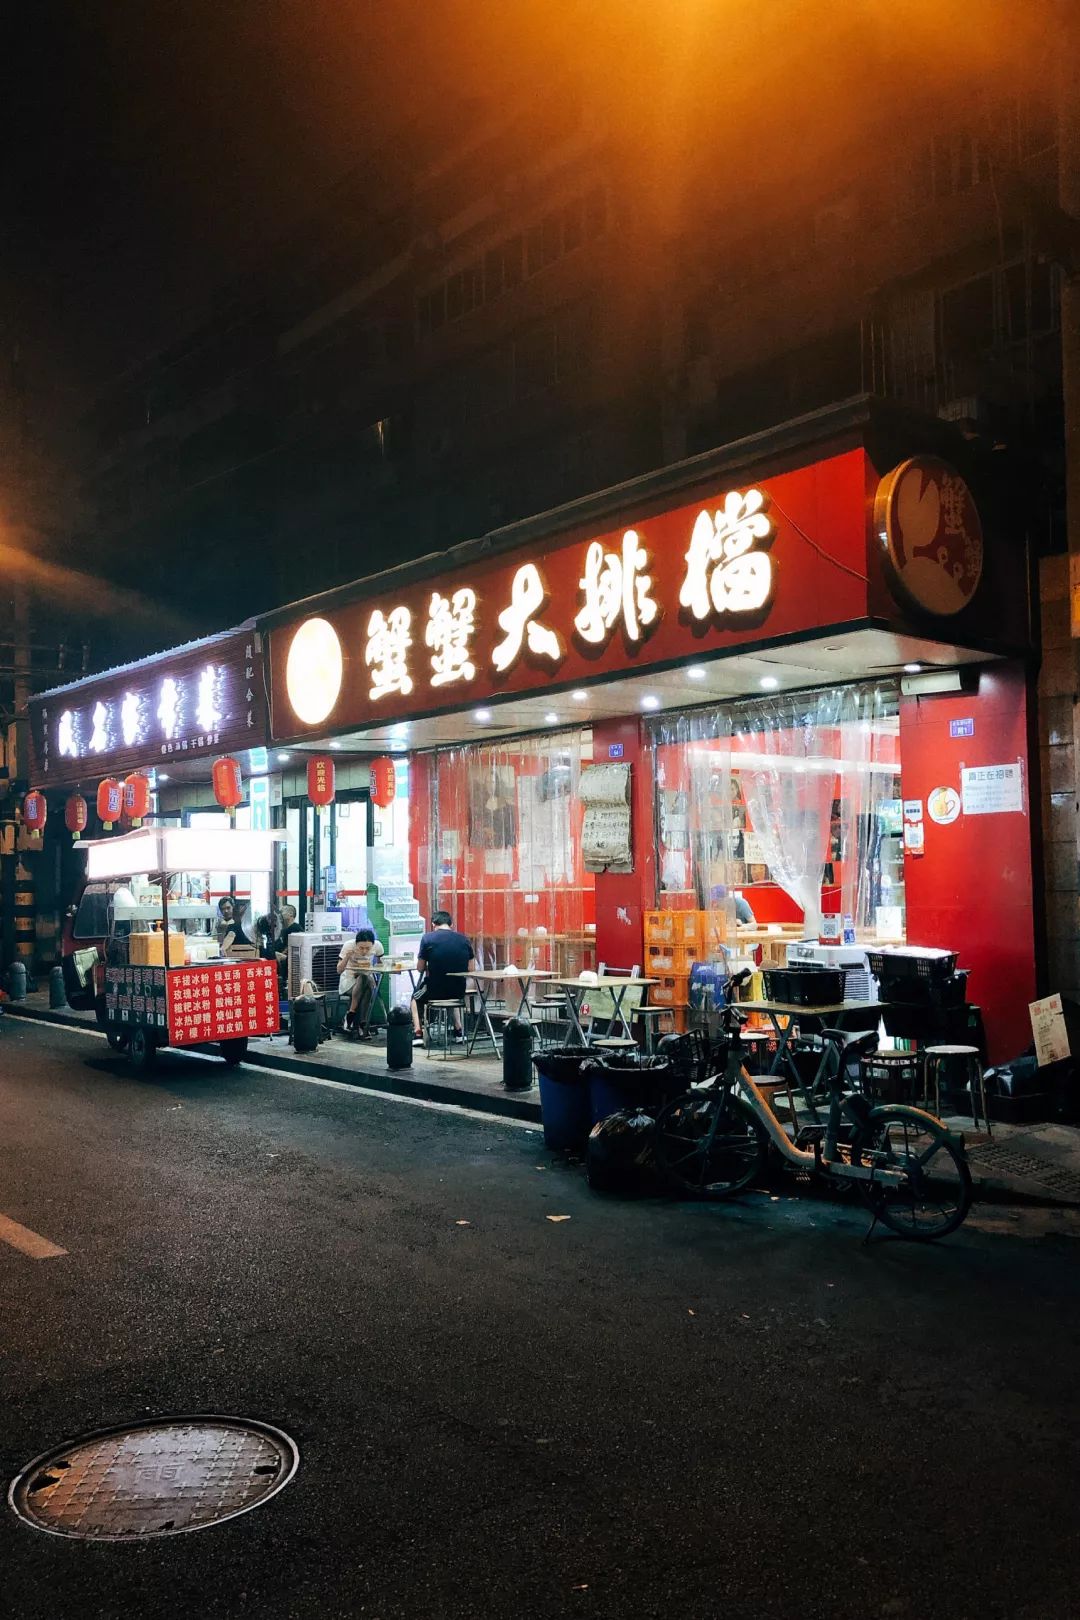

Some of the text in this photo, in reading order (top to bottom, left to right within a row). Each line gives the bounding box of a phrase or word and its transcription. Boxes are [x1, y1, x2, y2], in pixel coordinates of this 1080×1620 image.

[315, 760, 326, 792] 欢迎光临
[214, 969, 241, 982] 绿豆汤
[246, 965, 272, 978] 西米露
[173, 986, 210, 1000] 玫瑰冰粉
[215, 981, 241, 995] 龟苓膏
[174, 999, 211, 1014] 糍粑冰粉
[215, 994, 242, 1008] 酸梅汤
[216, 1007, 242, 1021] 烧仙草
[217, 1021, 243, 1034] 双皮奶
